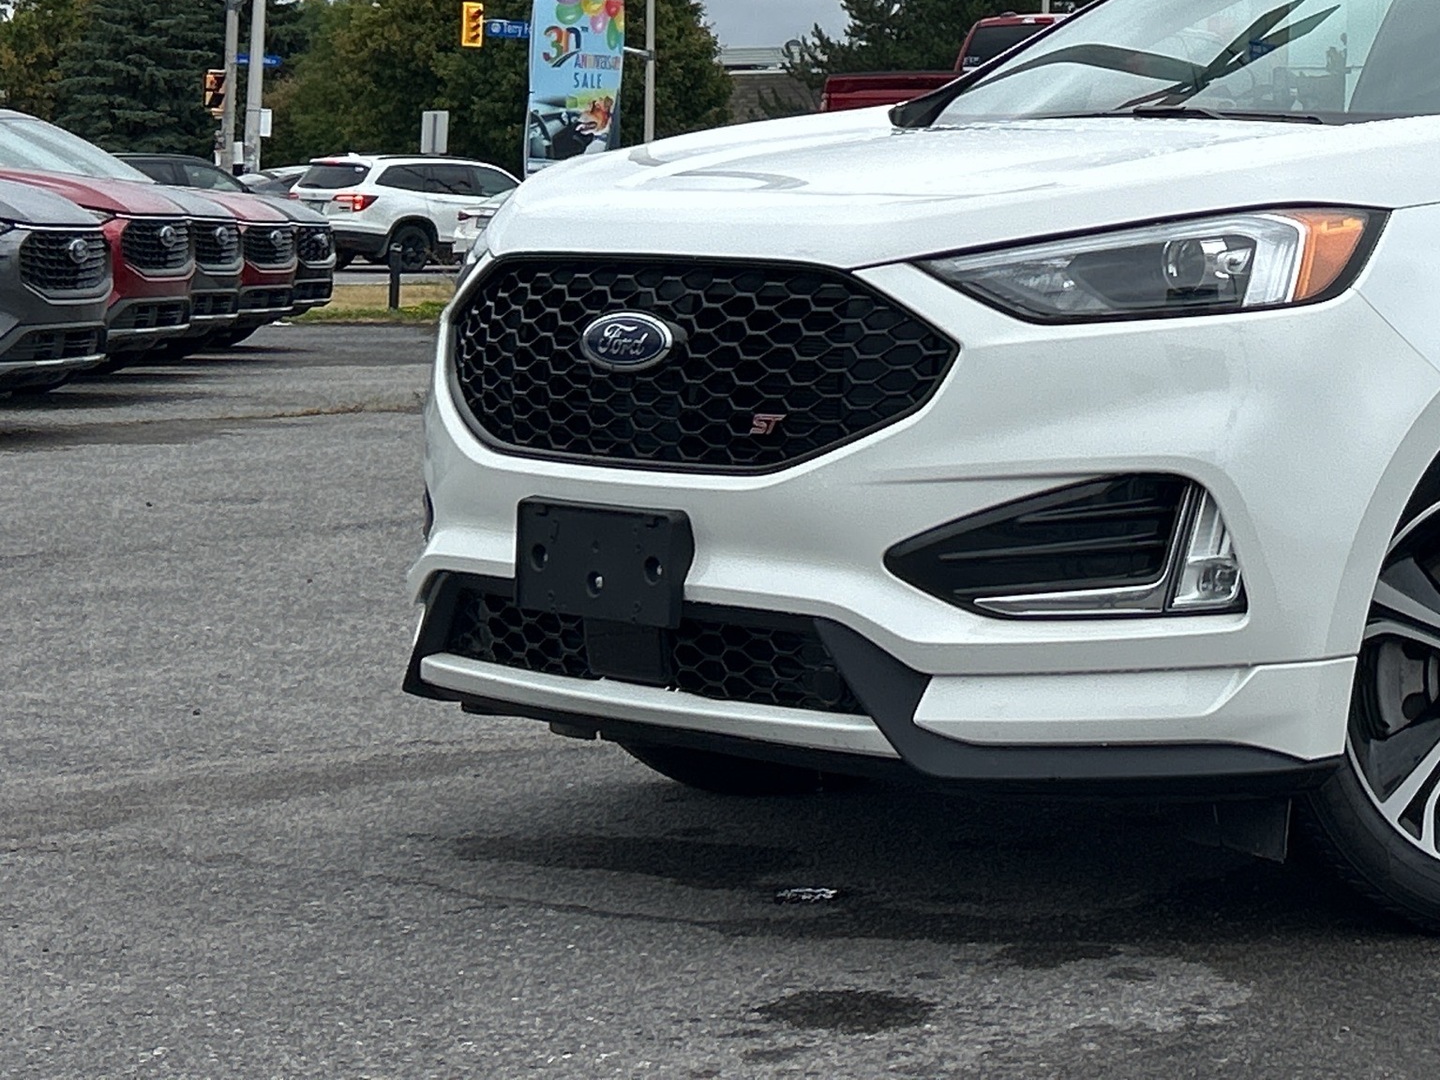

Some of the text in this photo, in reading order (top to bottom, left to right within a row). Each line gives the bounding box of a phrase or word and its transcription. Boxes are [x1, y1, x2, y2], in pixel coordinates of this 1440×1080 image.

[503, 22, 523, 37] Terry
[574, 72, 602, 89] SALE
[598, 323, 648, 354] Ford
[750, 414, 787, 434] ST
